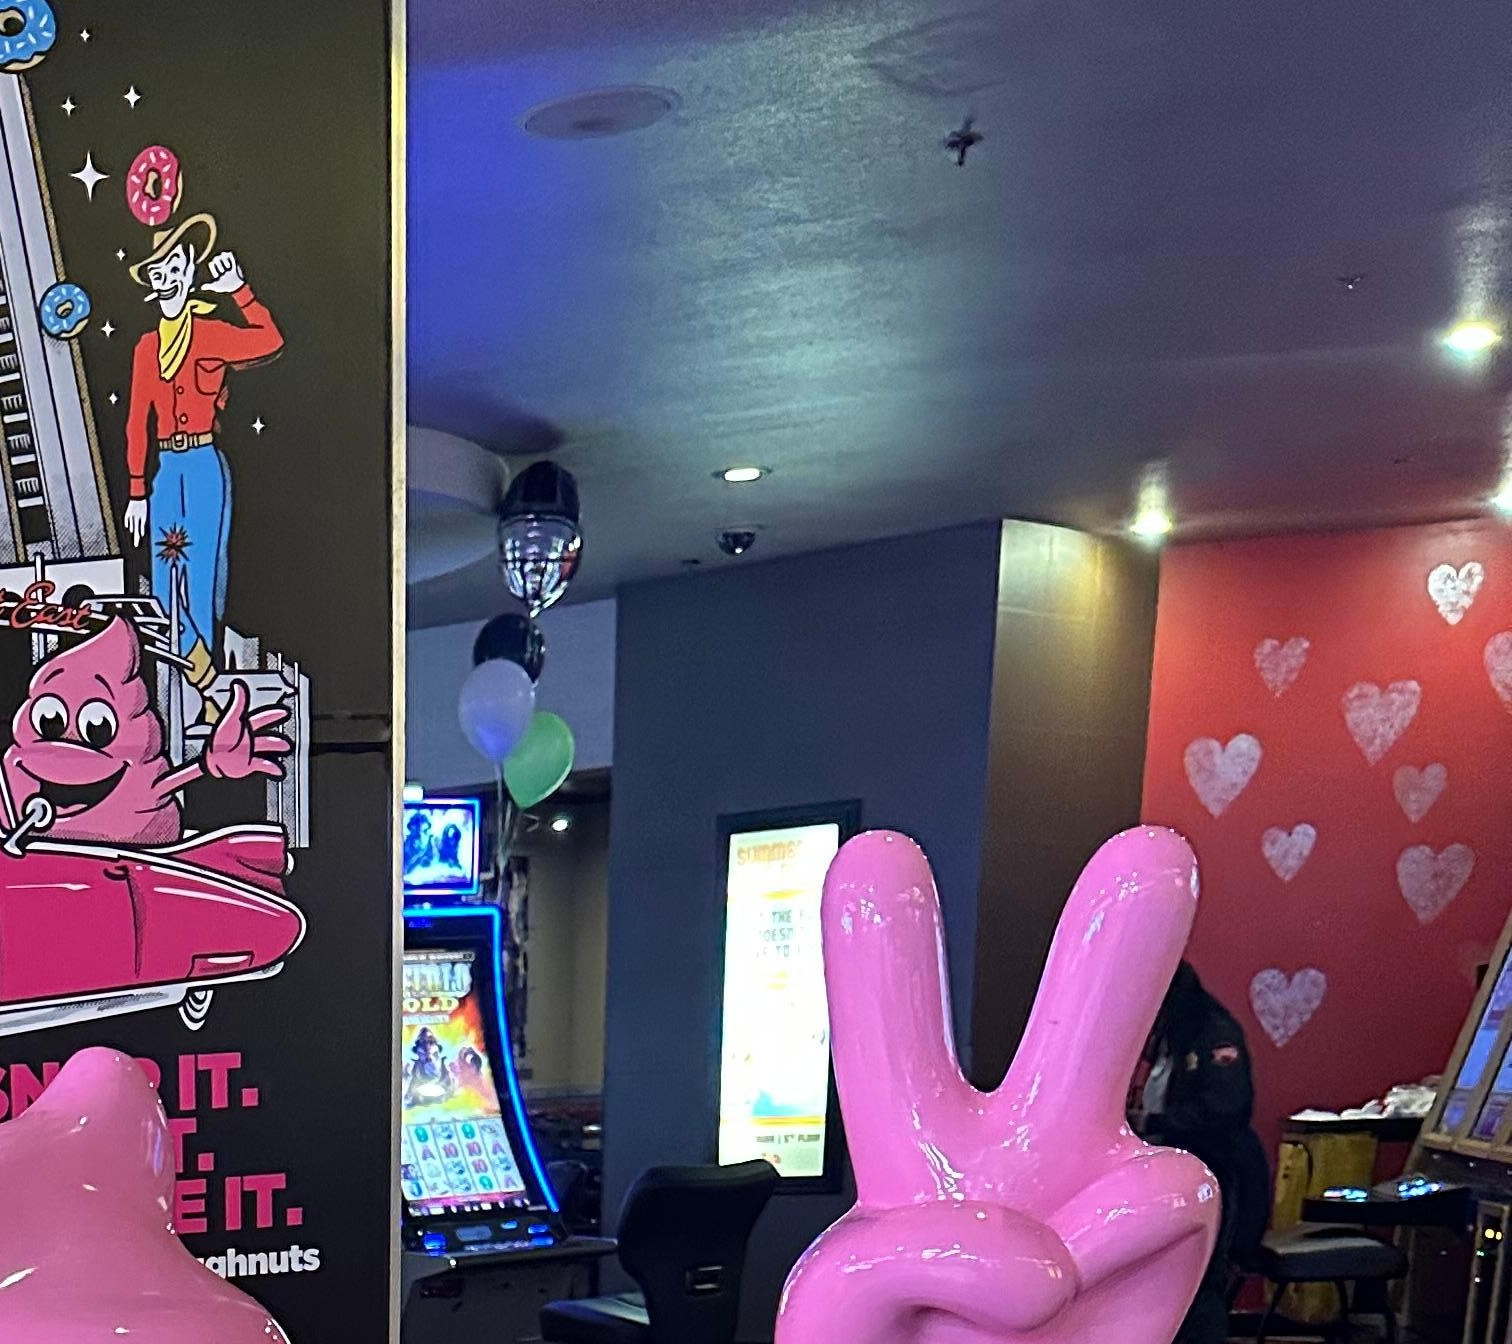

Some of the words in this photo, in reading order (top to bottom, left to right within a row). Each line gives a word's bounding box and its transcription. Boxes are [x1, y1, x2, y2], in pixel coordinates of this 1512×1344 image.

[402, 996, 460, 1013] OLD
[179, 1052, 259, 1111] IT.
[225, 1173, 304, 1231] IT.
